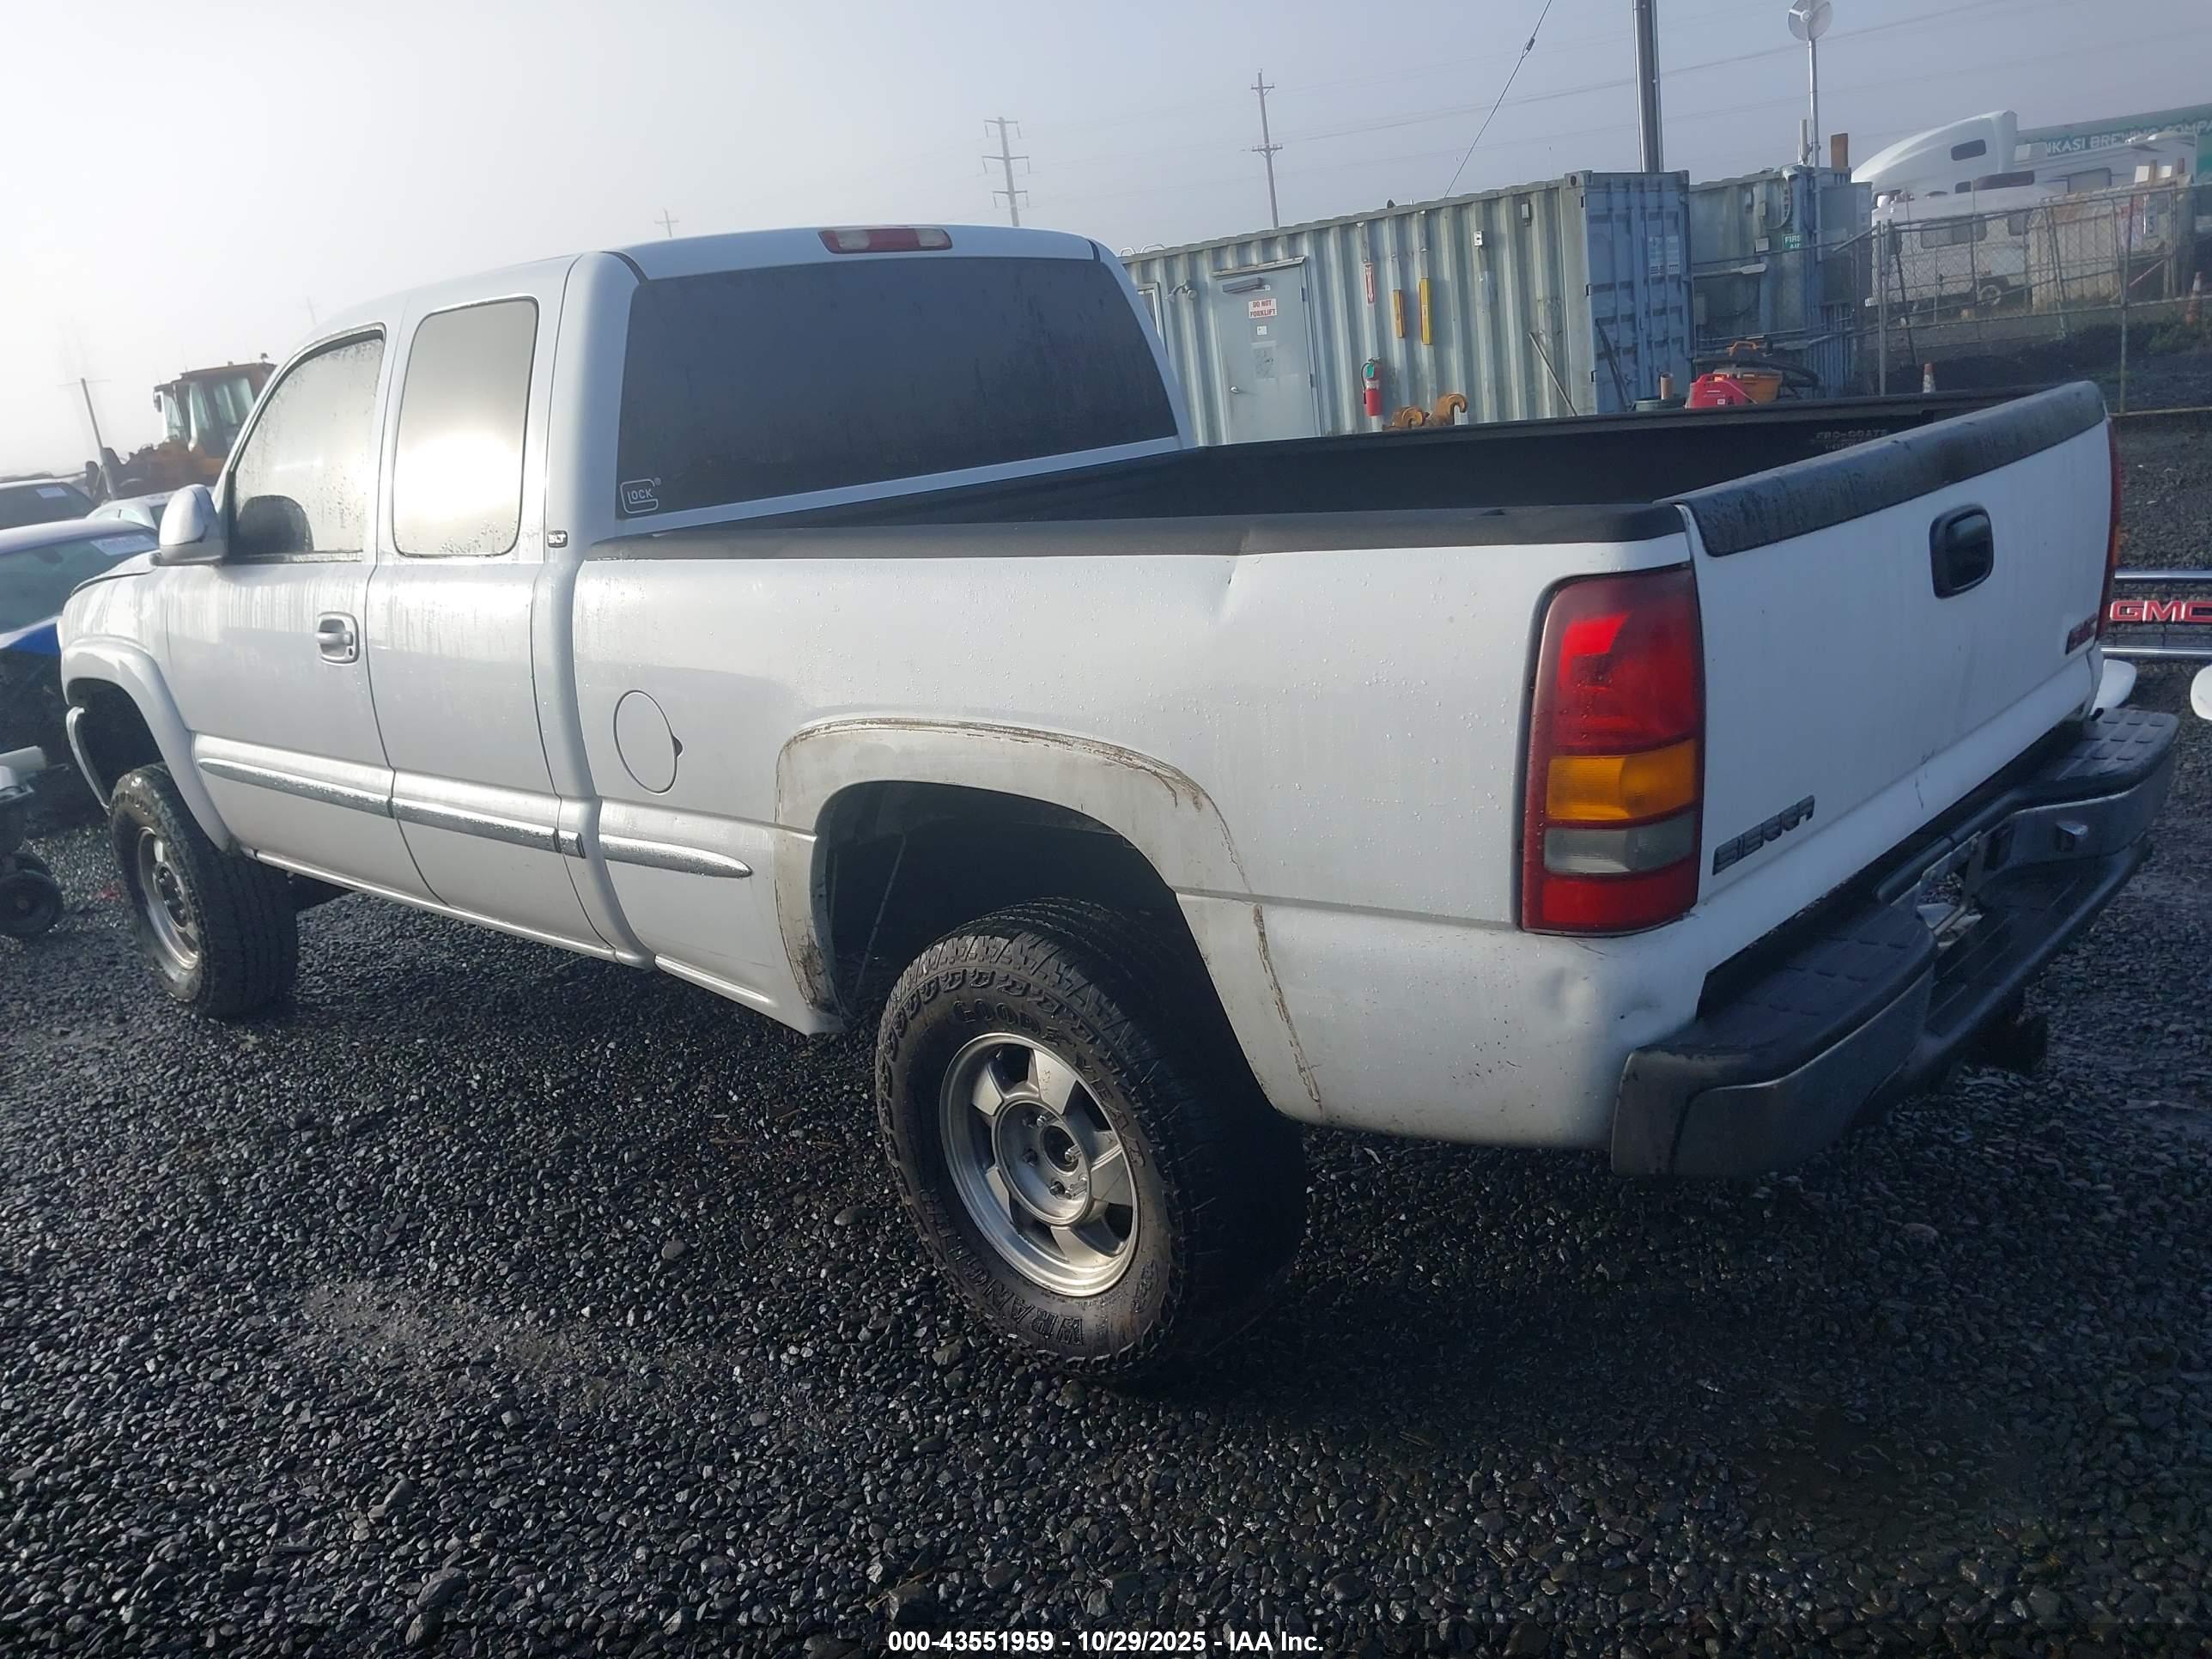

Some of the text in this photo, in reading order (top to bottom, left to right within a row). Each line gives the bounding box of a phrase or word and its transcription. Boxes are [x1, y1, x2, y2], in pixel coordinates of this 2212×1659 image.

[2046, 137, 2086, 154] NKASI
[1784, 234, 1801, 244] FIRS
[547, 533, 566, 544] SLT
[2110, 600, 2212, 623] GMC
[1711, 794, 1815, 876] SIERRA
[951, 998, 1146, 1168] GOODYEAR
